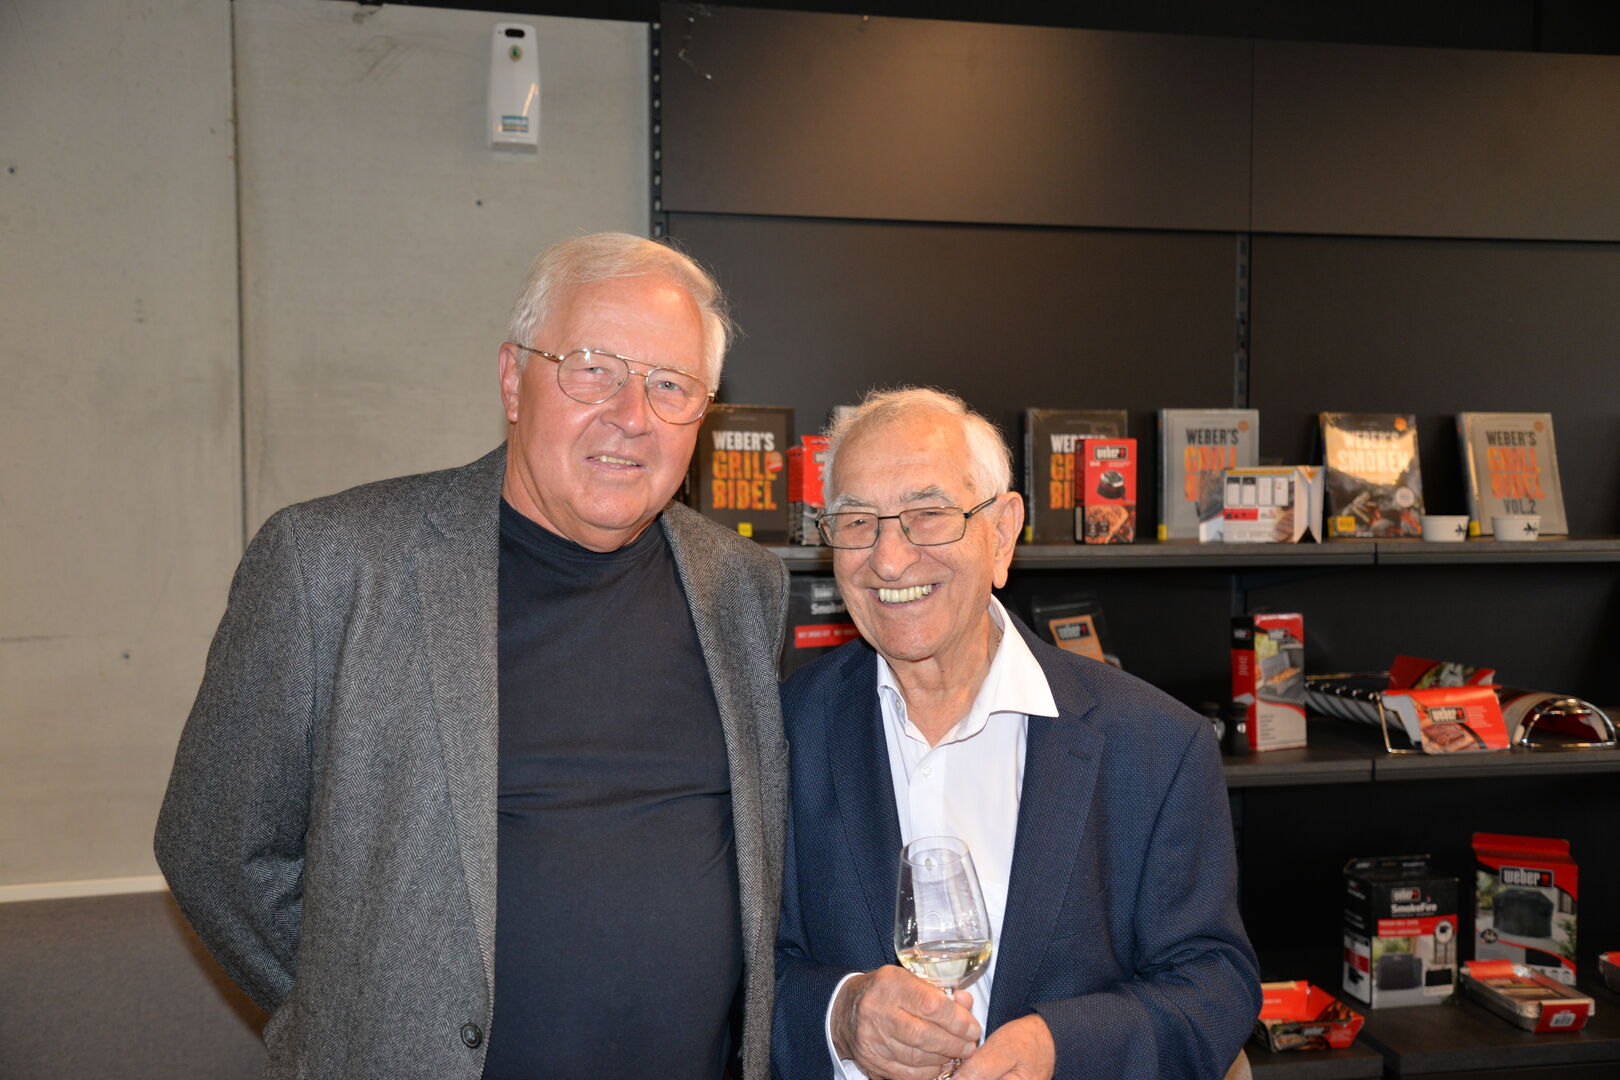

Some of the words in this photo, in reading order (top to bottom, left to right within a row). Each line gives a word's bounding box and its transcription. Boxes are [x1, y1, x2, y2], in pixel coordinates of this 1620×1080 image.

[712, 431, 775, 451] WEBER'S
[1185, 428, 1239, 445] WEBER'S
[1486, 430, 1537, 447] WEBER'S
[713, 450, 777, 480] GRILL
[1487, 448, 1541, 473] GRILL
[712, 480, 777, 510] BIBEL
[1489, 472, 1546, 499] BIBEL
[1504, 868, 1540, 886] weber
